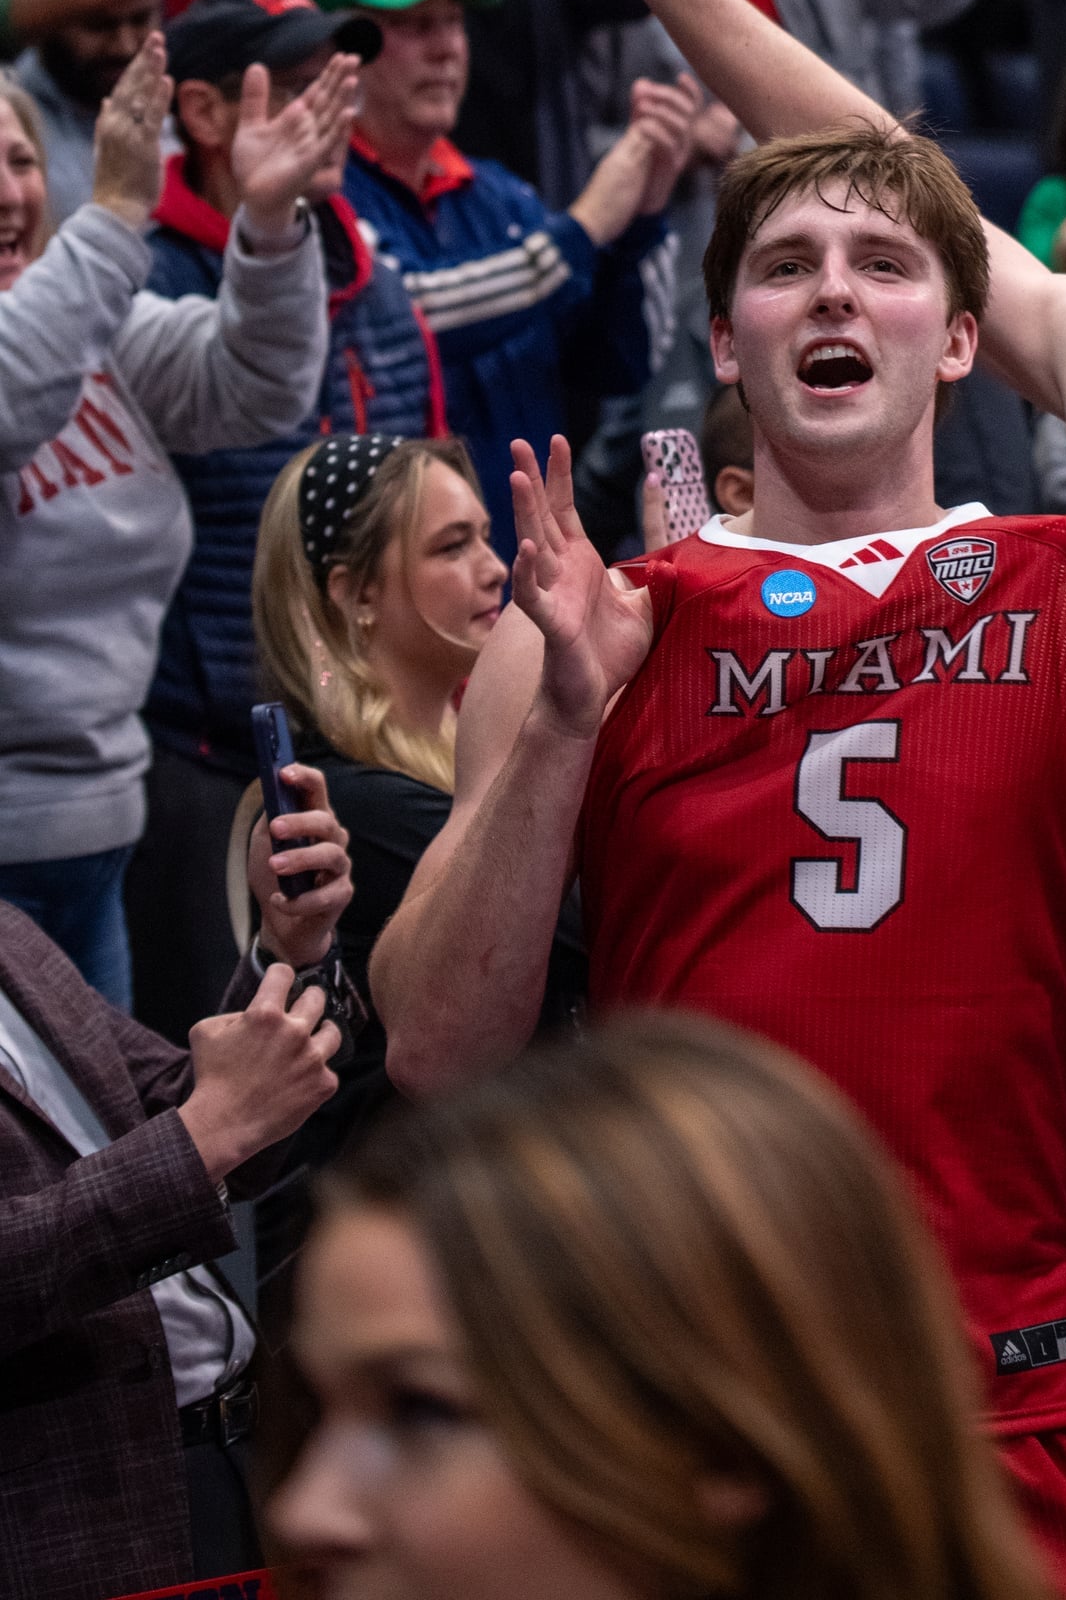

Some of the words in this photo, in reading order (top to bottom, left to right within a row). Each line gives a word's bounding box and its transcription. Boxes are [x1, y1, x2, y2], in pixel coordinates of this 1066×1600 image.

[936, 556, 993, 579] MAC
[769, 591, 814, 605] NCAA
[708, 611, 1039, 717] MIAMI
[789, 718, 907, 933] 5
[1000, 1353, 1027, 1366] adidas
[1040, 1342, 1048, 1356] L
